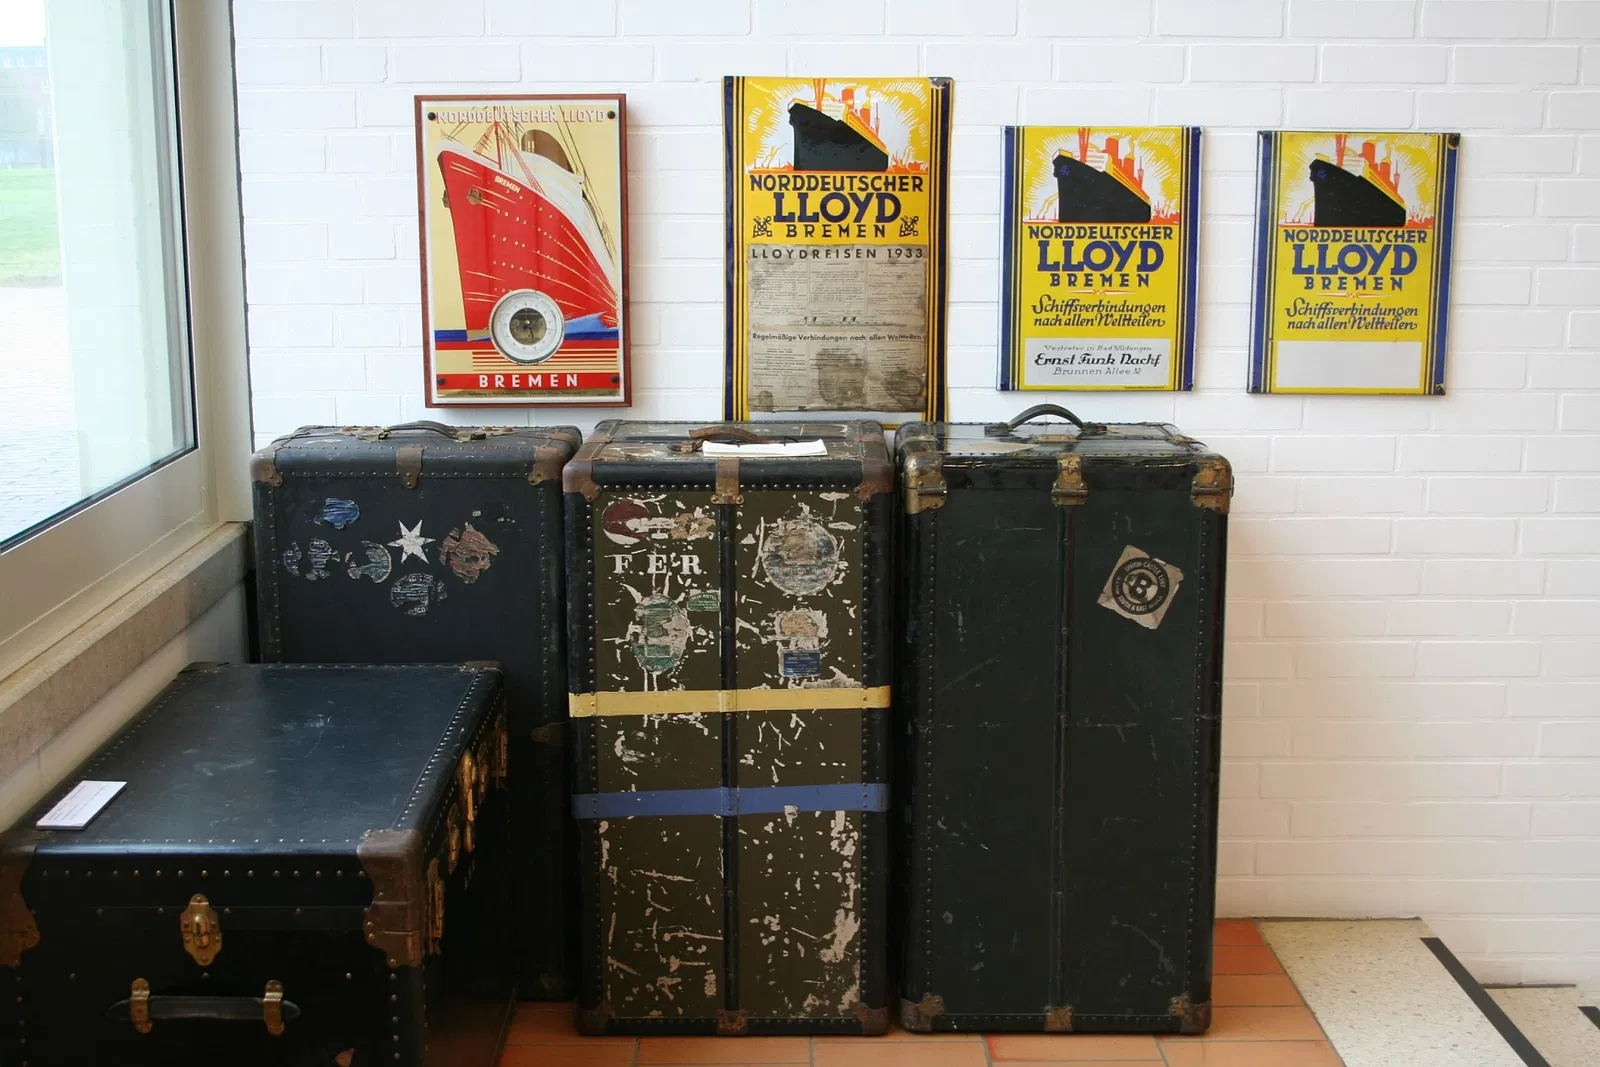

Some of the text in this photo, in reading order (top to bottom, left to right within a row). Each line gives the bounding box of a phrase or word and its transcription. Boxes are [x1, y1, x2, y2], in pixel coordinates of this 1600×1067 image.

[436, 109, 606, 124] NORDDEUTSCHER LLOYD
[494, 175, 521, 194] BREMEN
[750, 174, 924, 192] NORDDEUTSCHER
[773, 192, 902, 223] LLOYD
[786, 224, 886, 238] BREMEN
[1028, 225, 1173, 240] NORDDEUTSCHER
[1284, 229, 1427, 244] NORDDEUTSCHER
[887, 249, 924, 259] 1933
[1037, 240, 1164, 272] LLOYD
[1292, 244, 1417, 275] LLOYD
[1050, 273, 1150, 288] BREMEN
[1304, 276, 1403, 291] BREMEN
[1031, 294, 1166, 320] Schiffsverbindungen
[1285, 298, 1418, 323] Schiffsverbindungen
[1034, 312, 1166, 327] nach allen Weltteilen
[1287, 316, 1418, 330] nach allen Weltteilen
[752, 333, 797, 342] Regelmäßige
[798, 334, 848, 342] Verbindungen
[850, 333, 867, 341] nach
[869, 333, 886, 341] allen
[1034, 352, 1076, 366] Ernst
[1078, 353, 1116, 366] Funk
[1052, 367, 1142, 376] Brunnen Allee 32
[478, 373, 579, 388] BREMEN
